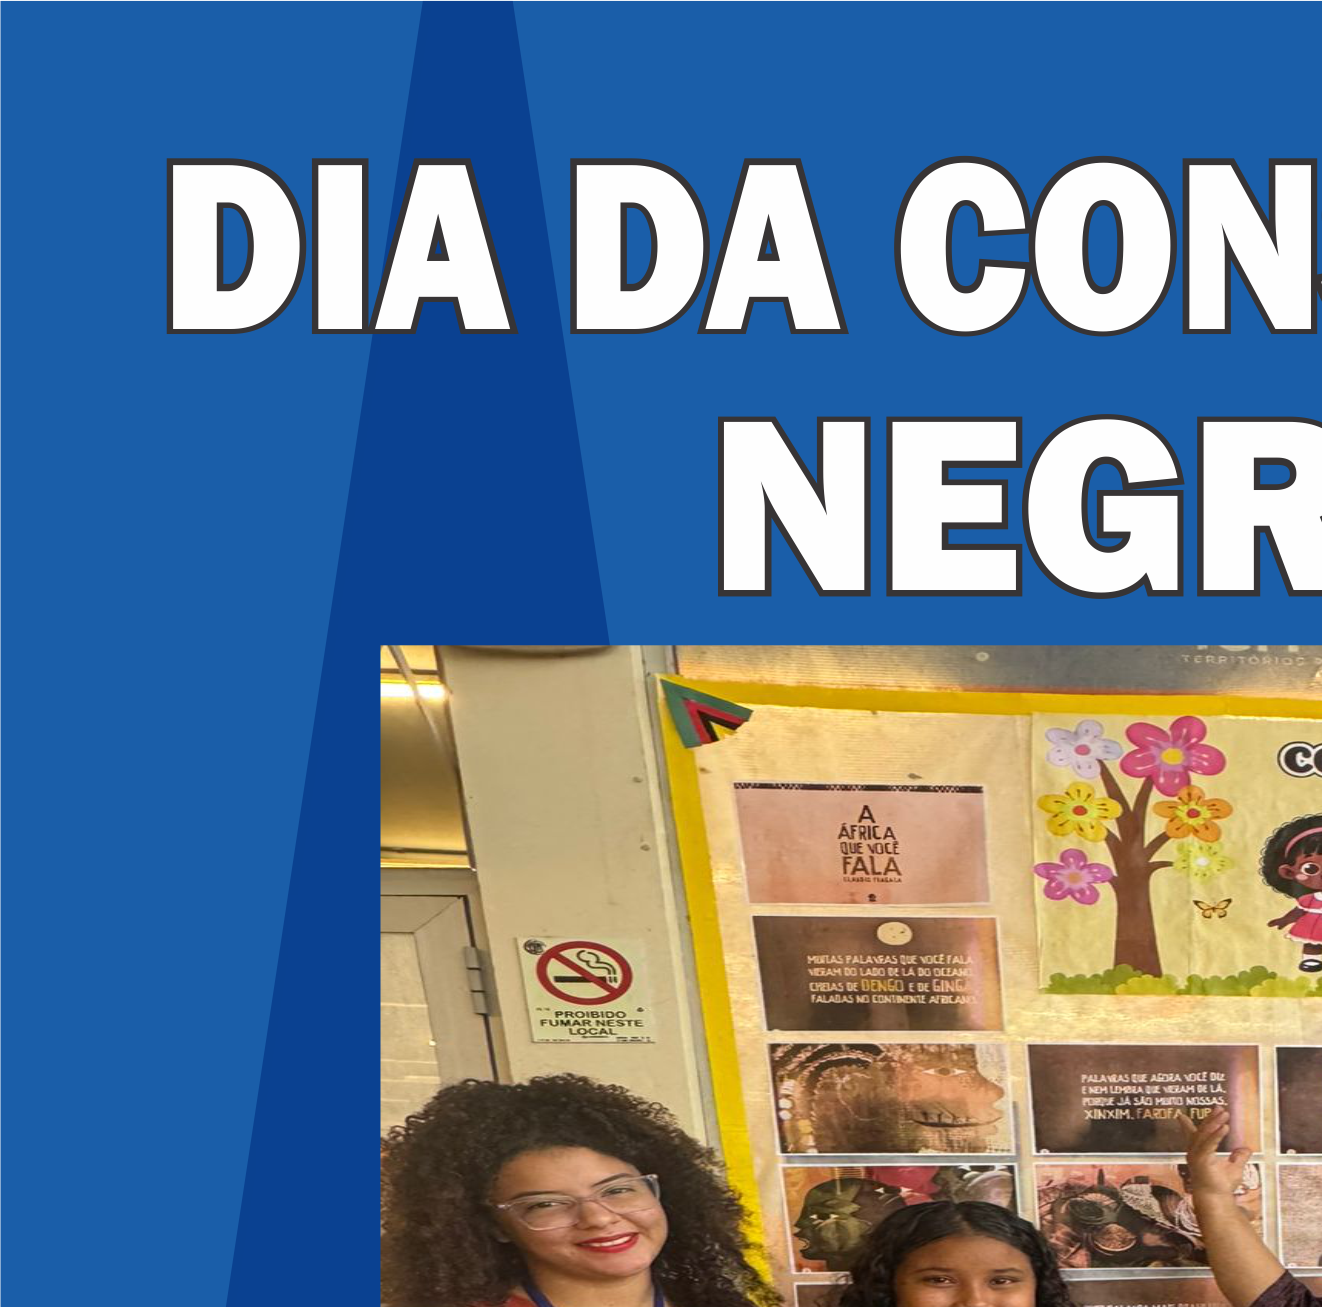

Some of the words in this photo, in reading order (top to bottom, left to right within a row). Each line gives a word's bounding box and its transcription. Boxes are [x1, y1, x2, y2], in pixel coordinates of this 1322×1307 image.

[858, 805, 876, 823] A
[837, 823, 897, 840] ÁFRICA
[840, 841, 864, 855] QUE
[867, 841, 900, 855] VOCÊ
[842, 855, 902, 876] FALA
[540, 1019, 592, 1027] FUMAR
